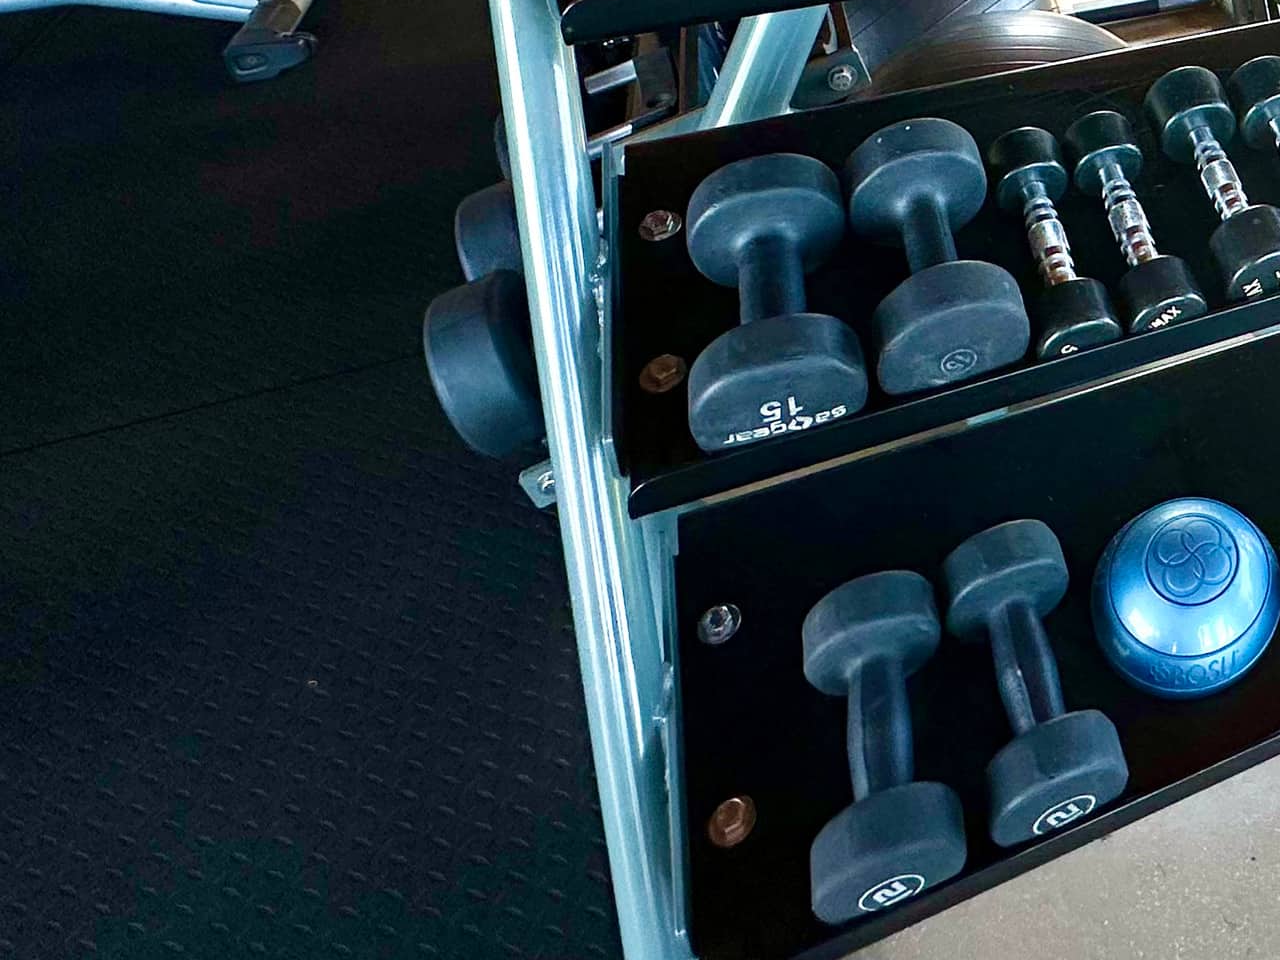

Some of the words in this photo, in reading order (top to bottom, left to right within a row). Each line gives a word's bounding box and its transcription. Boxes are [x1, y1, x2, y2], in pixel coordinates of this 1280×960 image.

[1148, 306, 1182, 330] MAX
[760, 396, 803, 423] 15
[1172, 649, 1240, 687] BOSU
